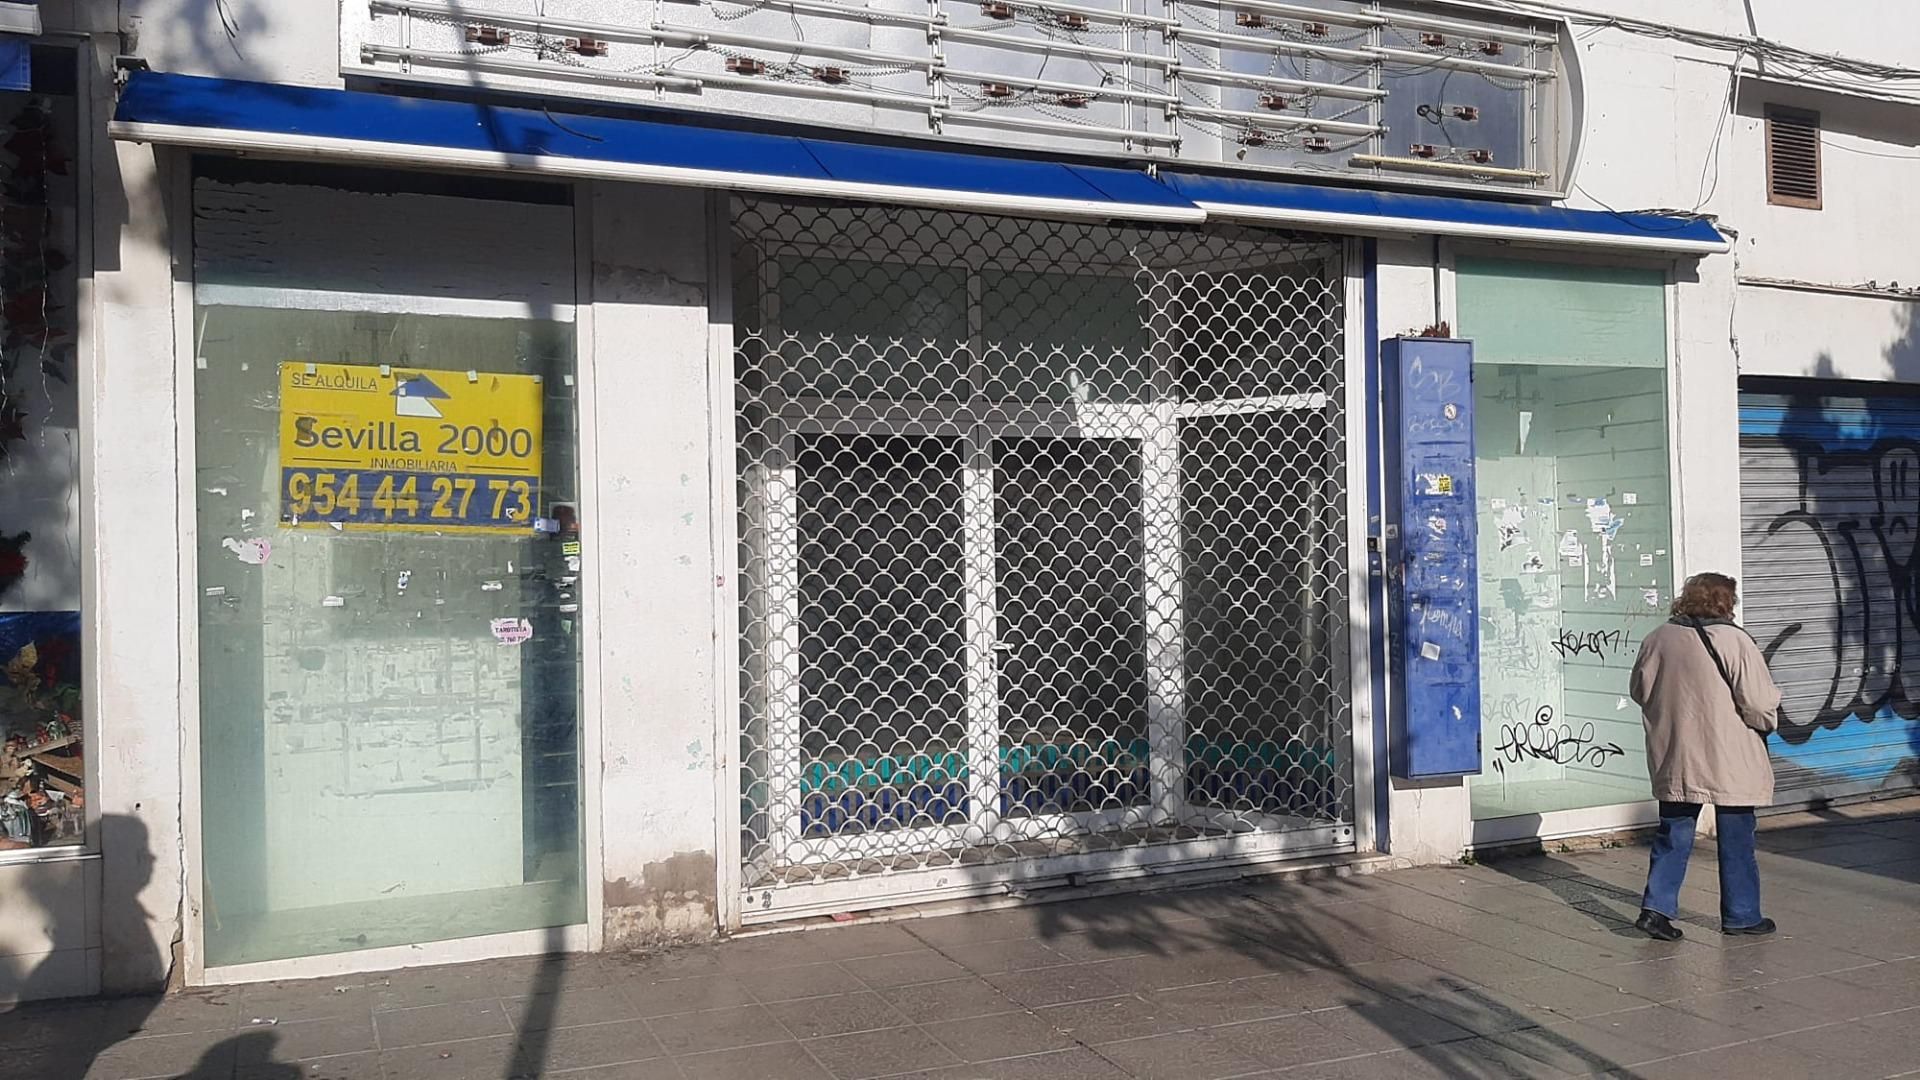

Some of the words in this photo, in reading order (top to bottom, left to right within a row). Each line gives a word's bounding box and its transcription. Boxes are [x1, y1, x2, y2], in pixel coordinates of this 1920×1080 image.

[292, 373, 313, 386] SE
[315, 374, 378, 391] ALQUILA
[294, 416, 422, 453] Sevilla
[437, 424, 533, 458] 2000
[370, 457, 458, 473] INMOBILIARIA
[288, 472, 361, 516] 954
[372, 475, 419, 518] 44
[431, 477, 476, 519] 27
[488, 479, 531, 522] 73
